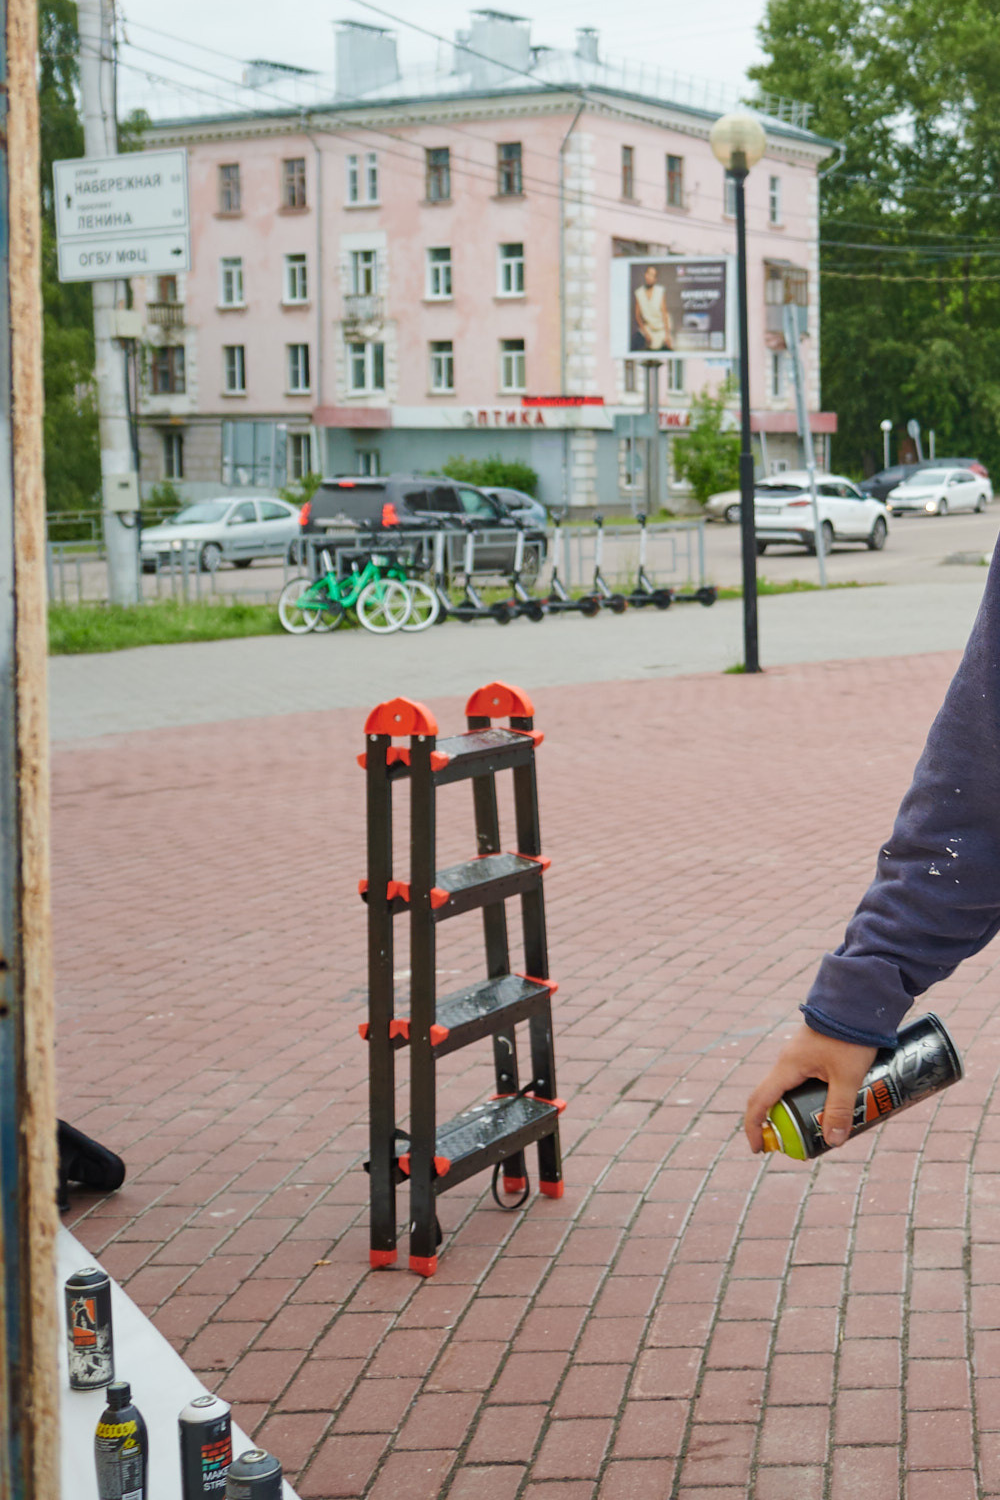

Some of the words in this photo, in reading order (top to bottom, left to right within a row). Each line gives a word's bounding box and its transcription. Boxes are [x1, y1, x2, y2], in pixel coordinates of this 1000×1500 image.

[74, 173, 162, 195] НАБЕРЕЖНАЯ
[78, 212, 133, 230] ЛЕНИНА
[79, 252, 111, 267] ОГБУ
[116, 249, 147, 264] МФЦ
[203, 1466, 229, 1482] MAKE
[203, 1477, 227, 1492] STRE
